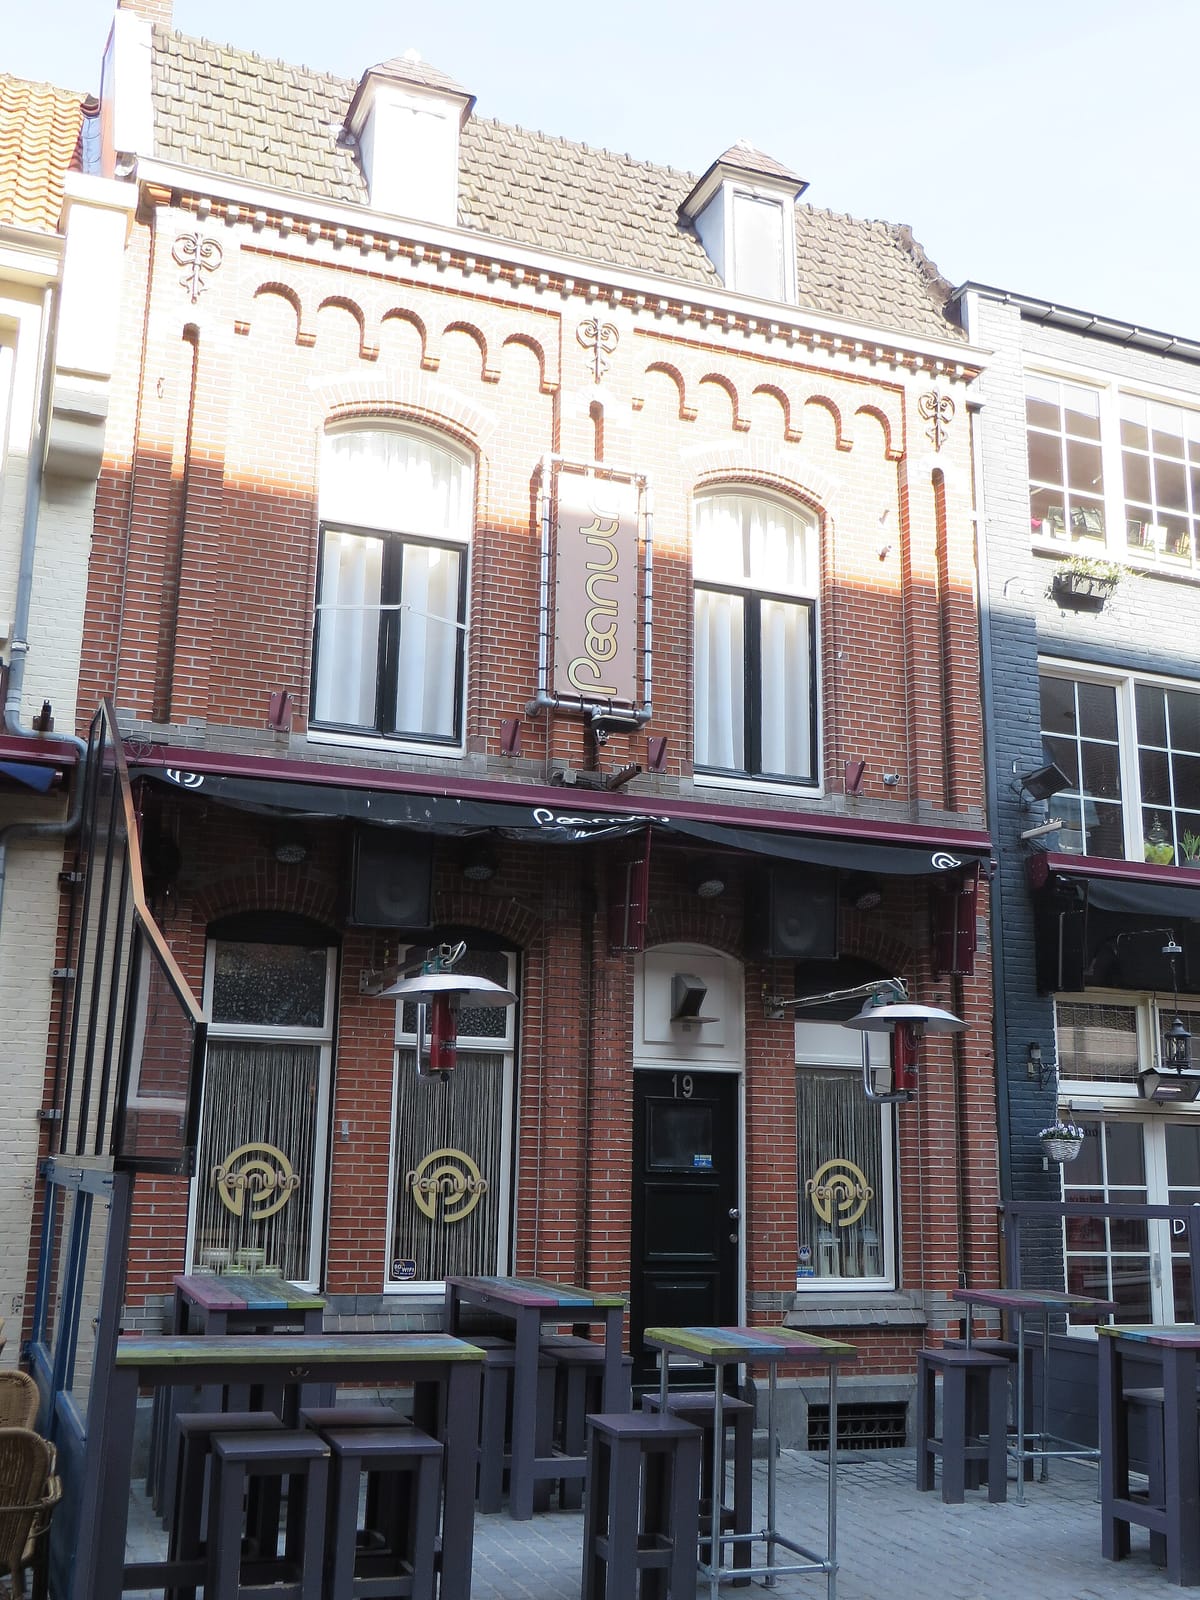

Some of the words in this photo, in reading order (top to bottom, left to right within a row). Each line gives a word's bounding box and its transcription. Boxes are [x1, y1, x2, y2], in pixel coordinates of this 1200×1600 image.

[671, 1074, 694, 1098] 19
[210, 1165, 301, 1189] Peanuts
[405, 1170, 489, 1193] Peanuts
[804, 1178, 875, 1200] Peanuts
